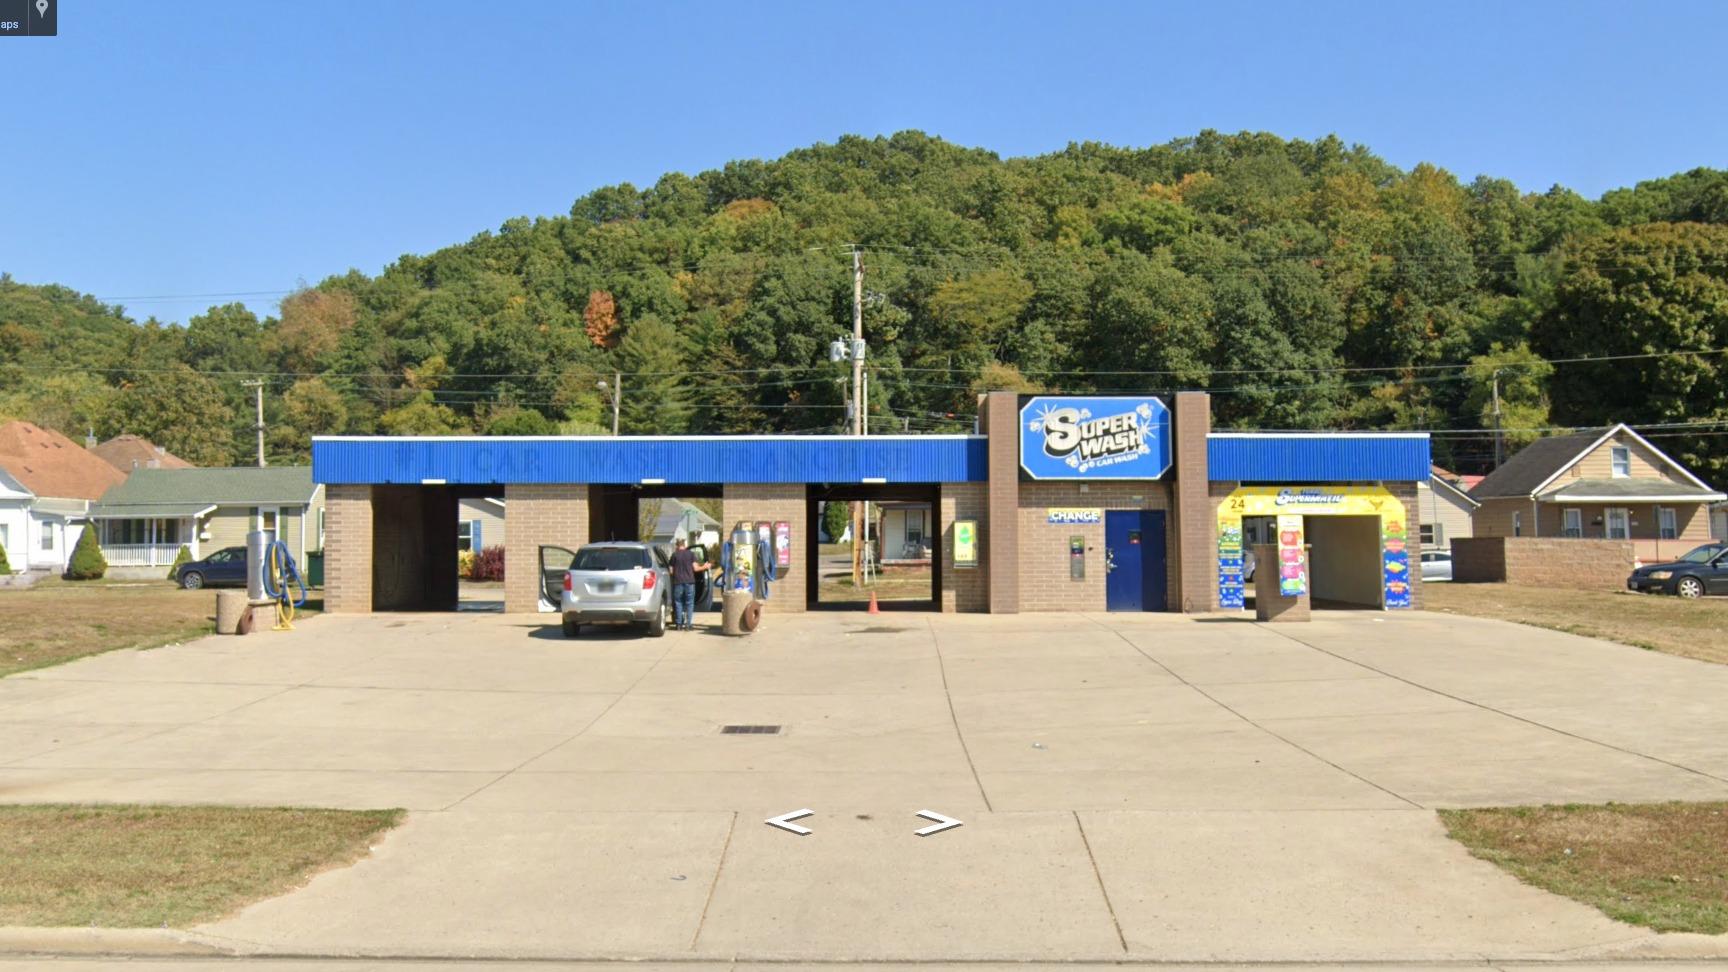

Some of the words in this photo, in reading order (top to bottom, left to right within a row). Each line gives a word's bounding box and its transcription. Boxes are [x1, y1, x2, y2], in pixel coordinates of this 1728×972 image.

[1043, 408, 1137, 456] SUPER
[1080, 430, 1141, 459] WASH
[471, 447, 542, 472] CAR
[580, 447, 673, 473] WASH
[1096, 457, 1112, 467] CAR
[1114, 453, 1139, 464] WASH
[1231, 498, 1245, 509] 24
[1051, 511, 1098, 521] CHANGE
